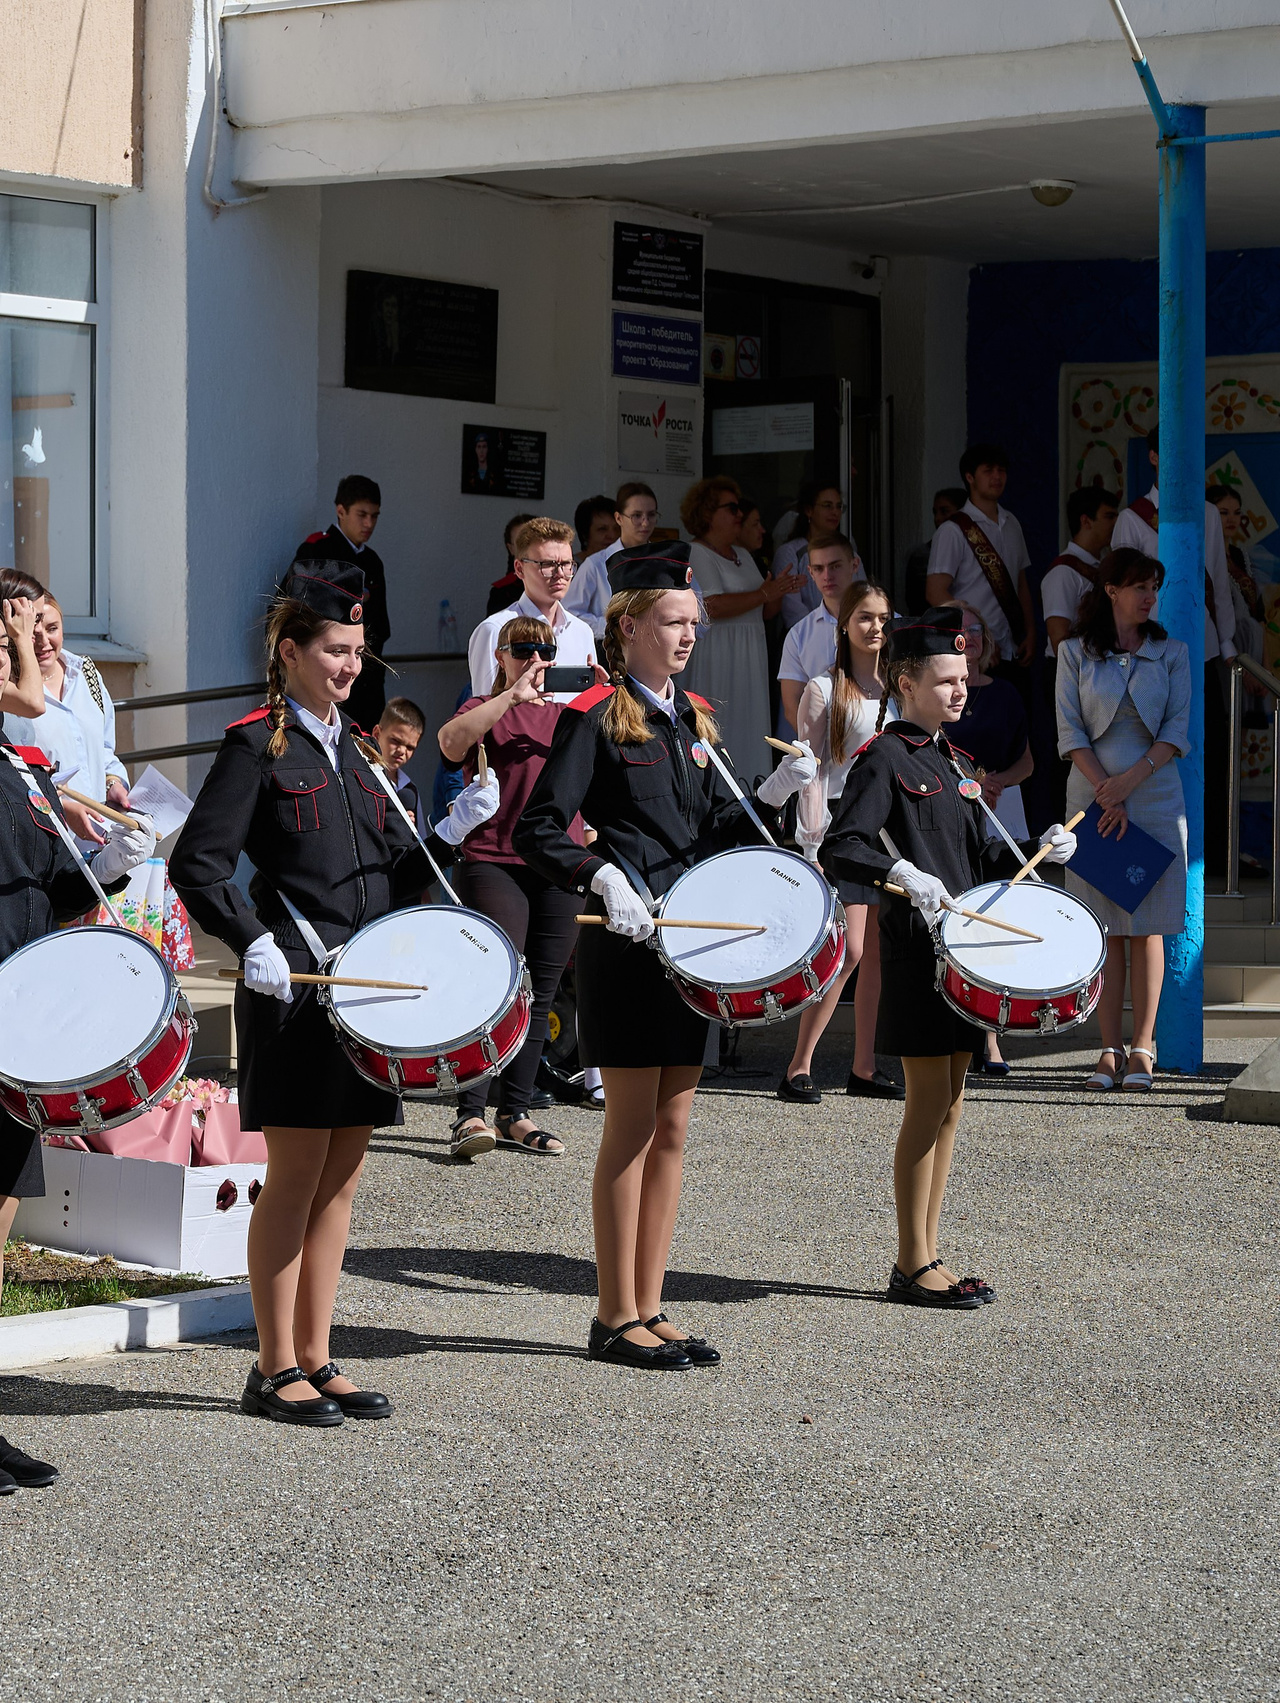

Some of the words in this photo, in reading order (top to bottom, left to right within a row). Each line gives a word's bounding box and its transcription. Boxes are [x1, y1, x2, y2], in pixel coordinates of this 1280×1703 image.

[621, 321, 646, 335] Школа
[651, 326, 694, 342] победитель
[616, 338, 657, 351] приоритетного
[658, 345, 699, 356] национального
[622, 355, 647, 366] проекта
[621, 413, 651, 427] ТОЧКА
[665, 418, 693, 432] РОСТА
[770, 867, 801, 888] BRAHNER
